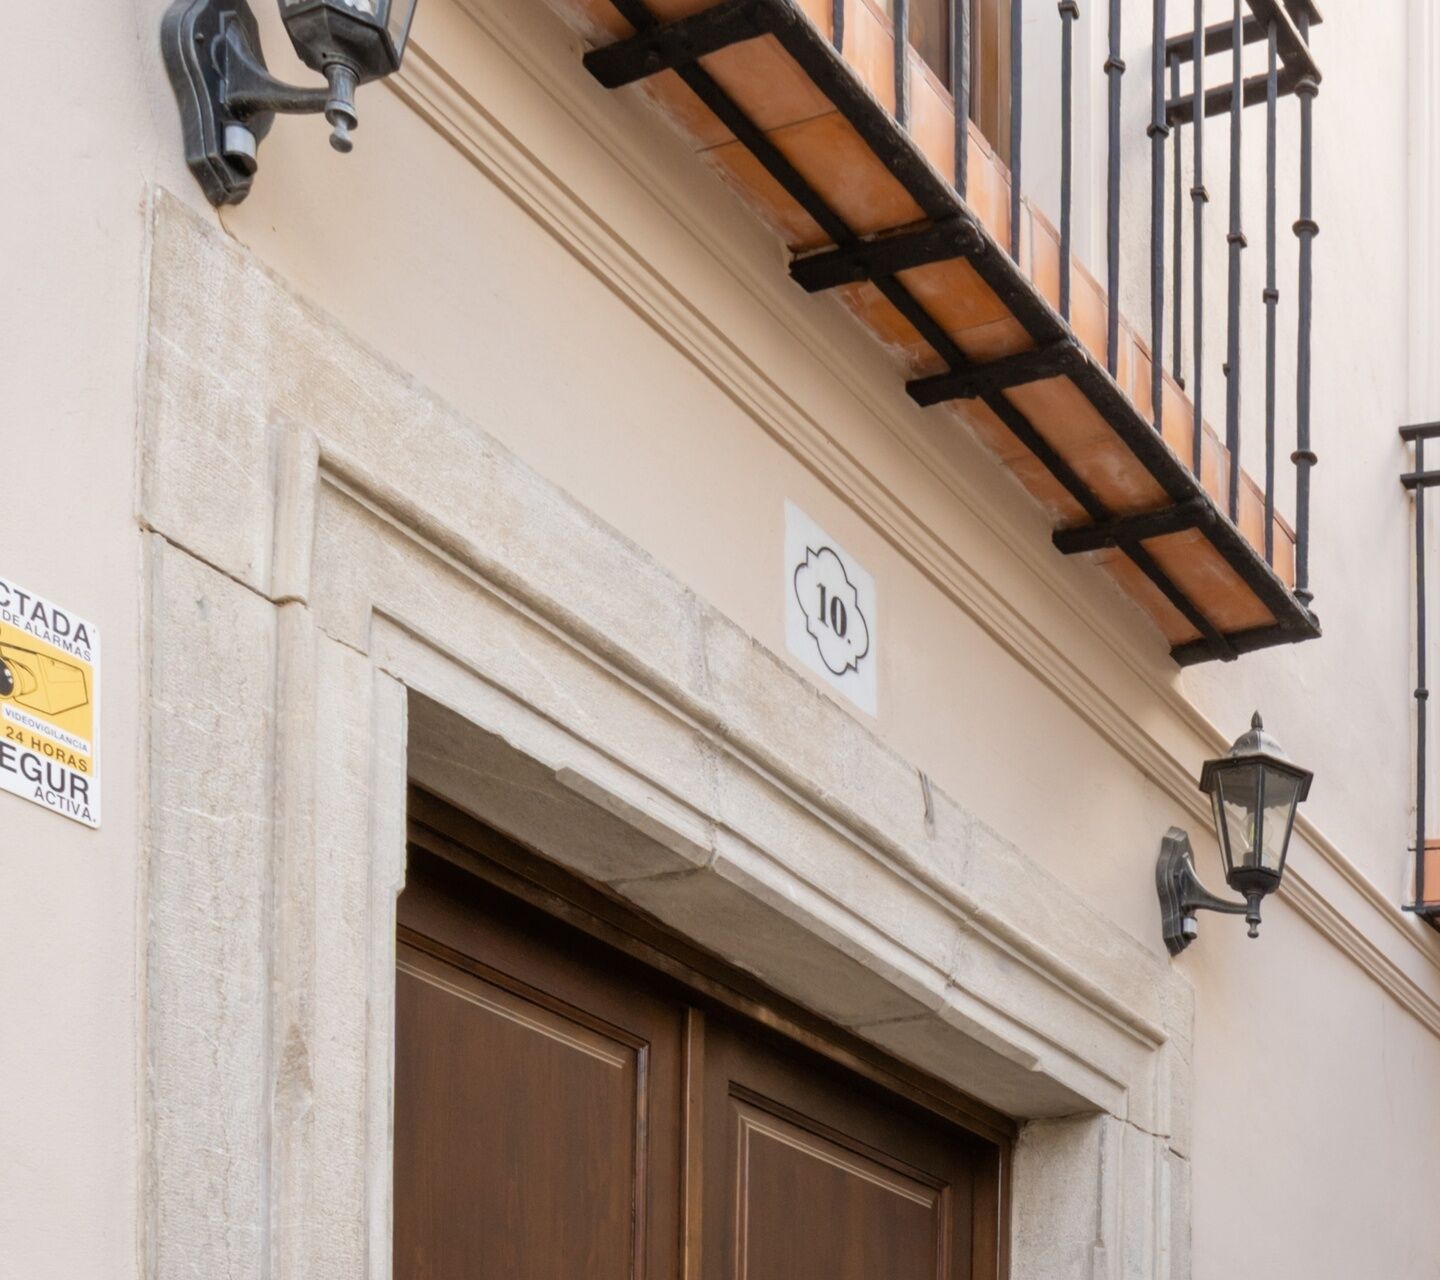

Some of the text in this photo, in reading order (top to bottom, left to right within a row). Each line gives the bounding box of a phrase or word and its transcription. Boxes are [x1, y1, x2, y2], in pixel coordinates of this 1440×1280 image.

[2, 609, 92, 662] DE ALARMAS
[5, 707, 88, 752] VIDEOVIGILANCIA
[5, 725, 88, 773] 24 HORAS
